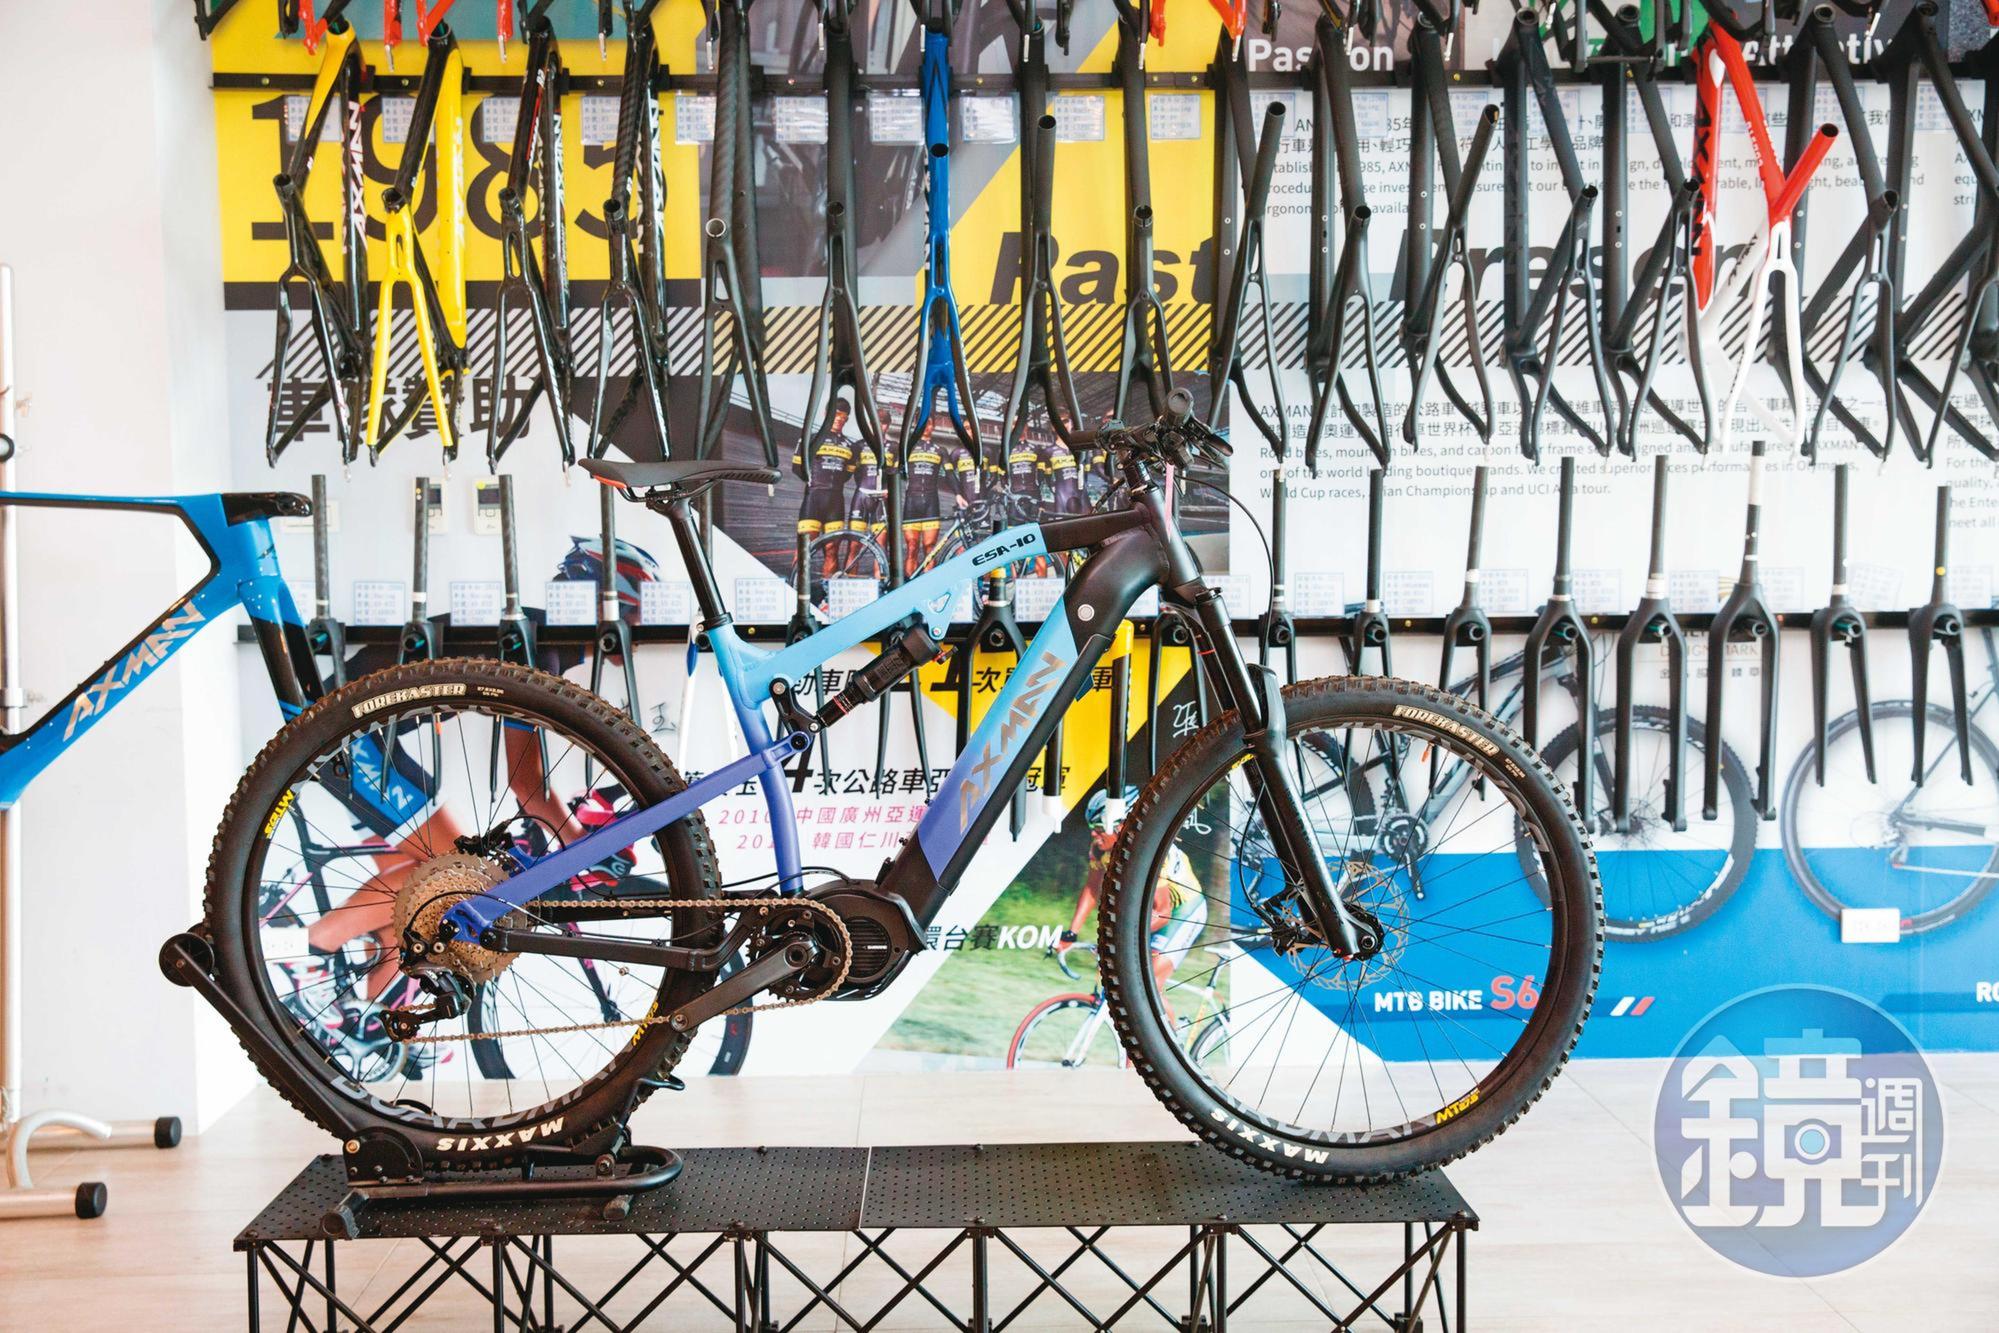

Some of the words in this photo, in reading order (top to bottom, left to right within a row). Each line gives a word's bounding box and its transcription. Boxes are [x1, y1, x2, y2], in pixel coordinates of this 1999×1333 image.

[1248, 39, 1393, 72] Pason
[1327, 465, 1363, 478] world
[1416, 464, 1473, 480] boutique
[1301, 487, 1325, 501] Cup
[62, 602, 206, 743] AXMAN
[959, 651, 1067, 835] AXMAN
[1374, 991, 1424, 1013] MTB
[1429, 989, 1483, 1012] BIKE
[1490, 975, 1540, 1011] S6
[436, 1117, 565, 1152] MAXXIS
[1210, 1107, 1330, 1164] MAXXIS
